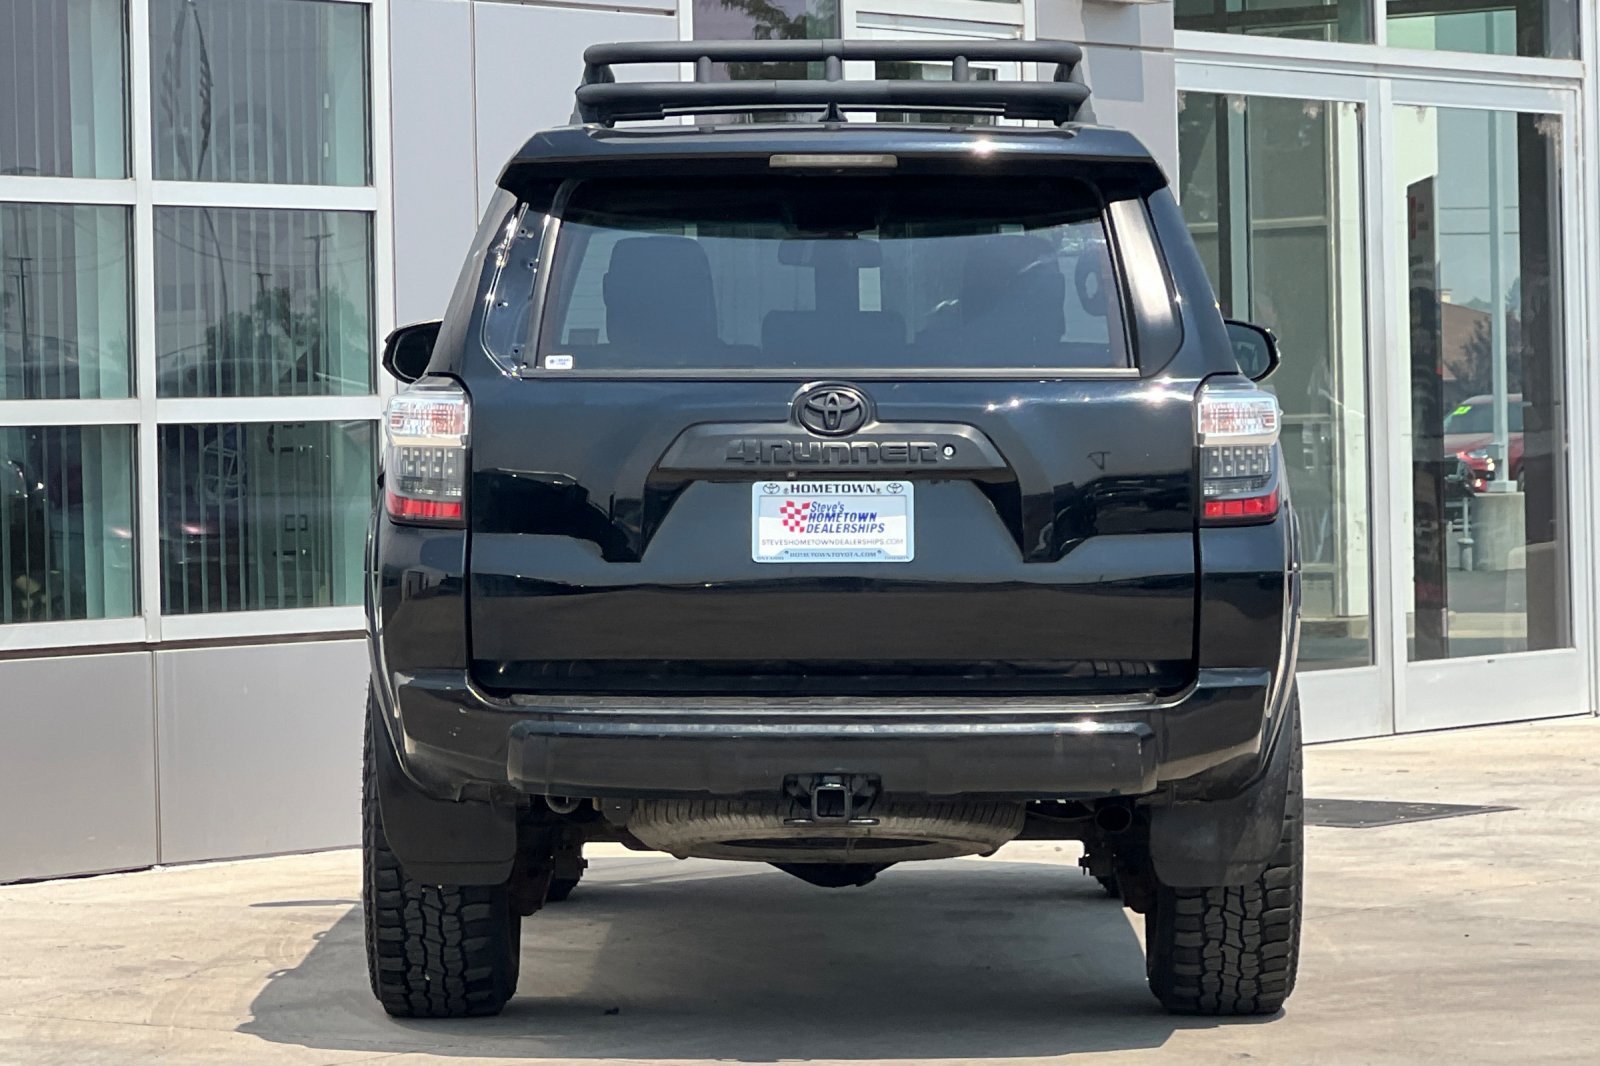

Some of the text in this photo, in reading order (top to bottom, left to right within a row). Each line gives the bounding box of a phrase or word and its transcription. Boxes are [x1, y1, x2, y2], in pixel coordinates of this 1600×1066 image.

[725, 439, 938, 465] 4RUNNER
[791, 484, 875, 494] HOMETOWN
[811, 501, 845, 513] Steve's
[809, 512, 877, 523] HOMETOWN
[806, 523, 885, 533] DEALERSHIPS
[761, 538, 904, 546] STEVESHOMETOWNDEALERSHIPS.COM
